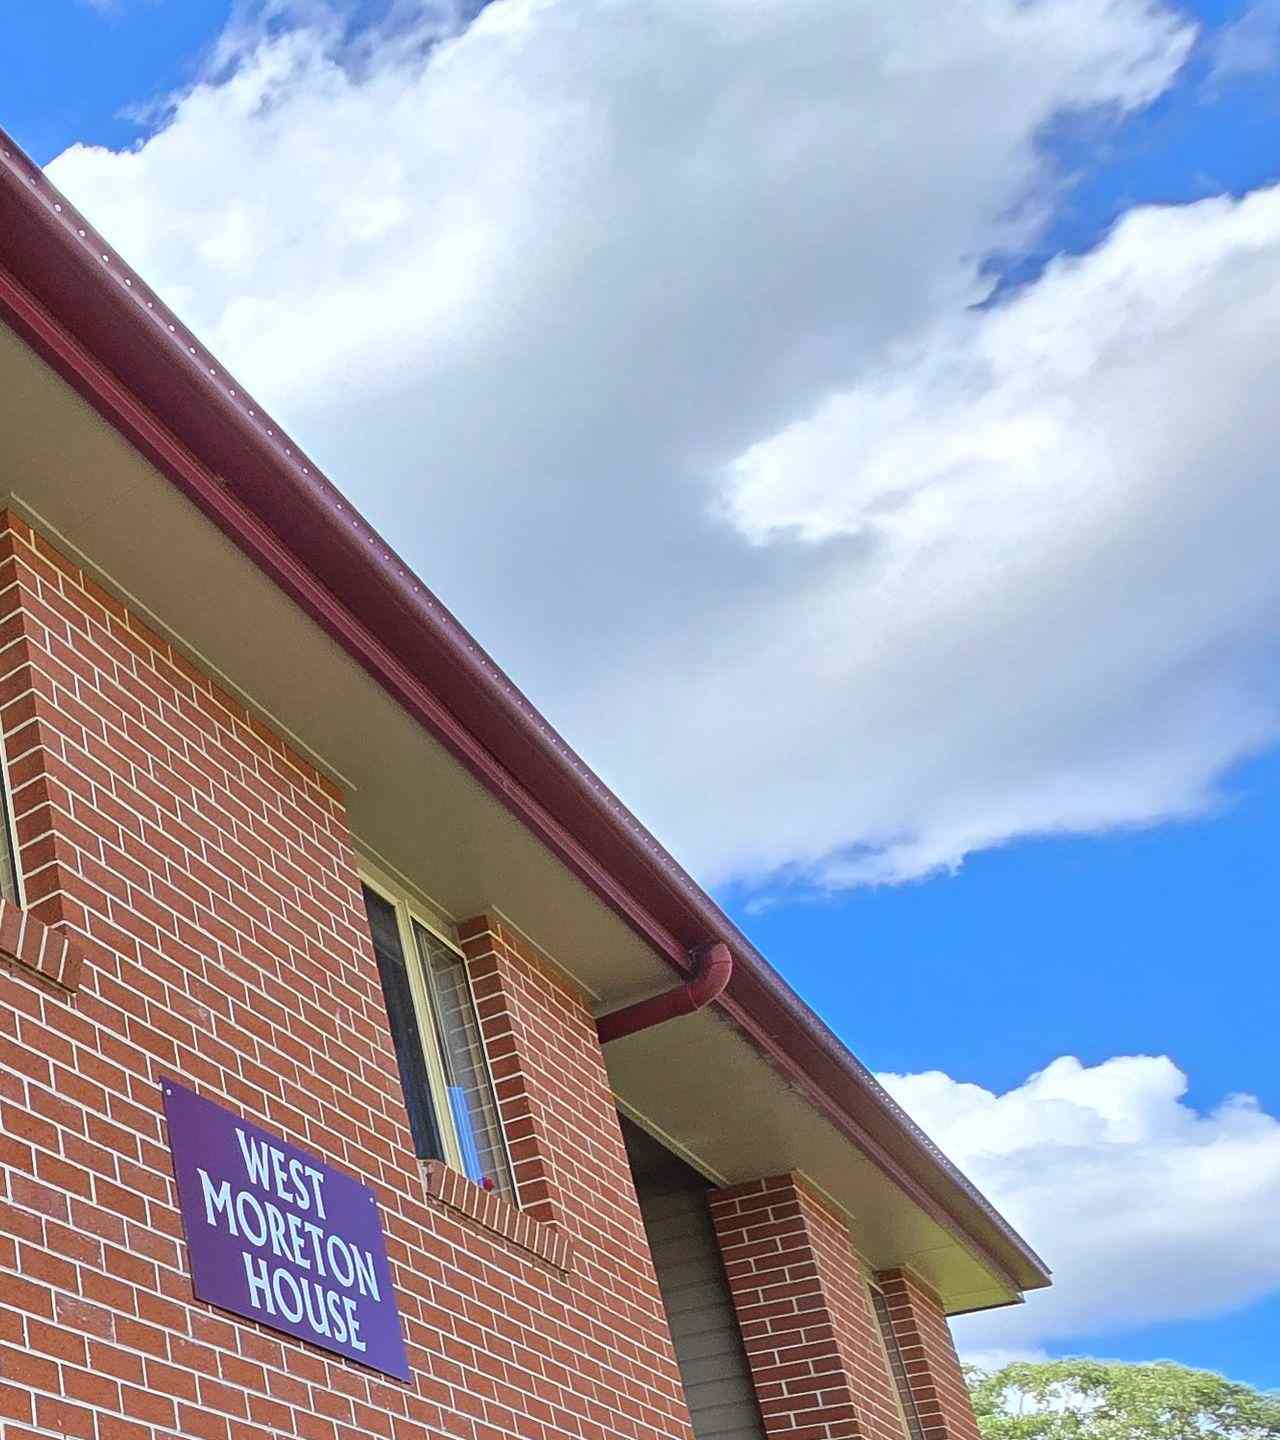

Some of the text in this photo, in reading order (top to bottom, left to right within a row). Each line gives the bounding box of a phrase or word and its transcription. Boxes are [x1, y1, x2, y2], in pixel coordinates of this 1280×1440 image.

[236, 1128, 326, 1219] WEST
[197, 1168, 381, 1301] MORETON
[243, 1252, 366, 1352] HOUSE
